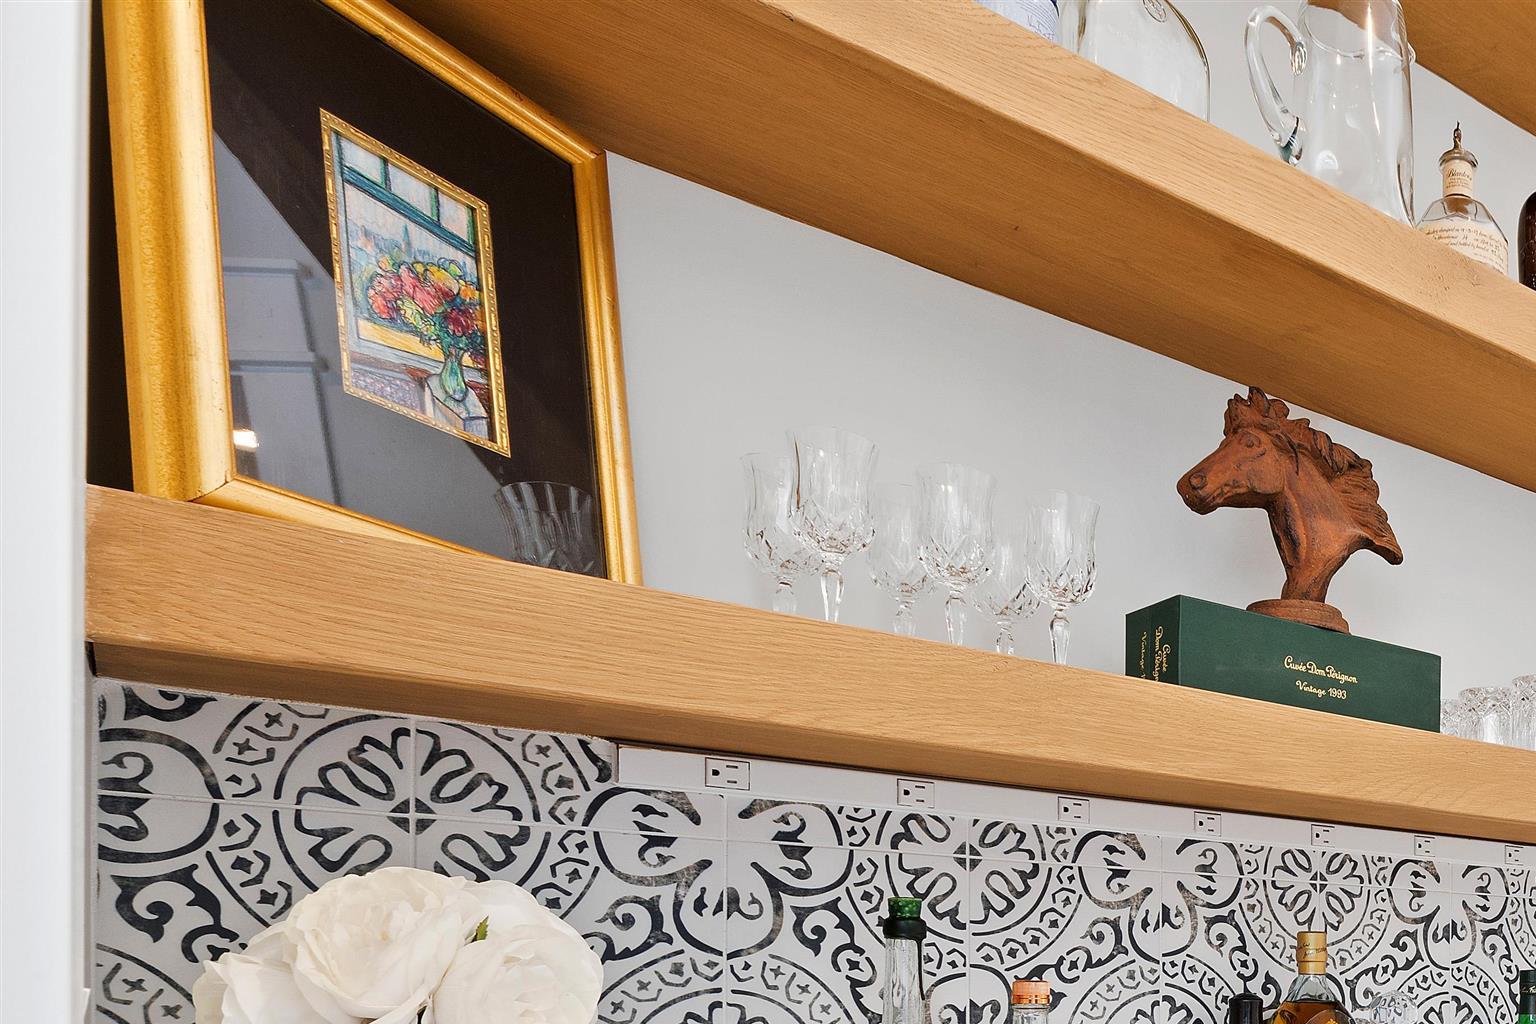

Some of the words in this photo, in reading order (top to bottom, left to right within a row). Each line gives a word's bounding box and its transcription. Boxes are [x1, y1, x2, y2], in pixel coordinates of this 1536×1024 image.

[1306, 661, 1327, 677] Dom
[1295, 680, 1327, 698] Vintage
[1327, 687, 1347, 700] 1993
